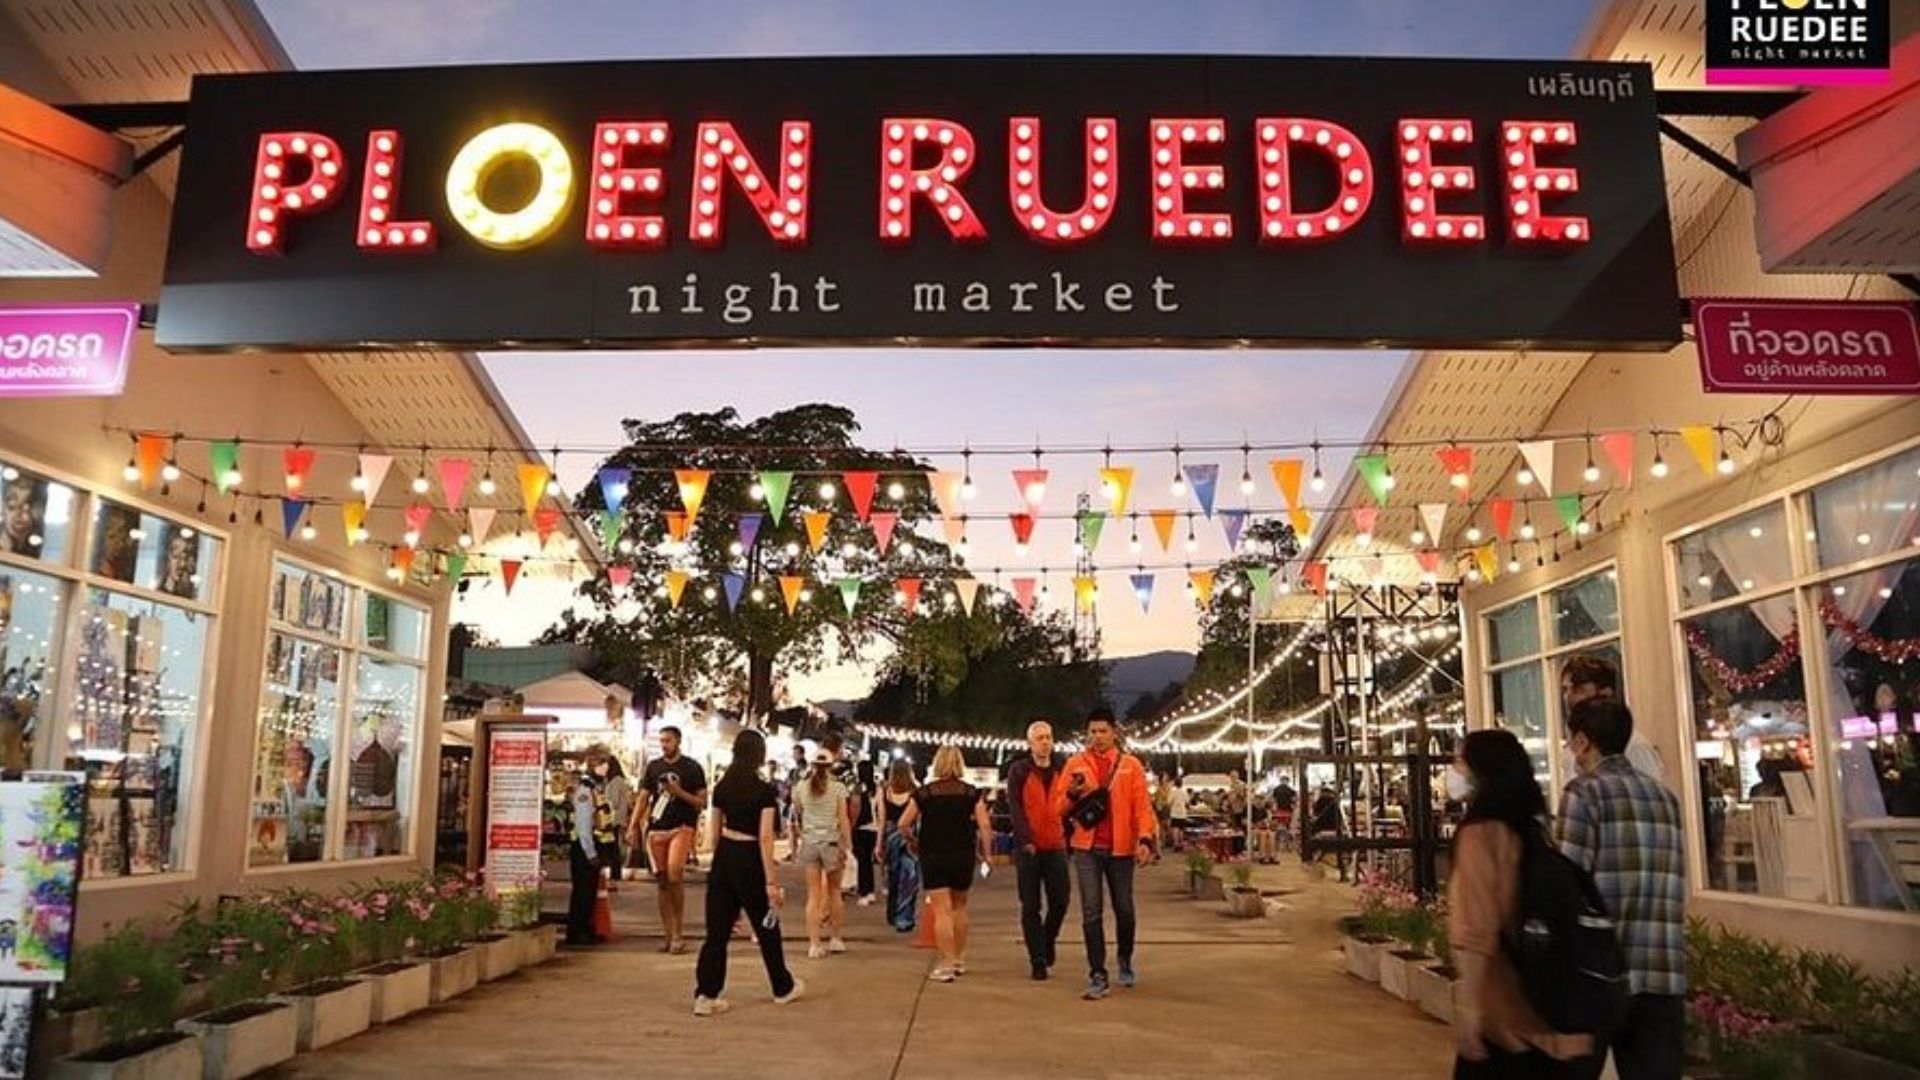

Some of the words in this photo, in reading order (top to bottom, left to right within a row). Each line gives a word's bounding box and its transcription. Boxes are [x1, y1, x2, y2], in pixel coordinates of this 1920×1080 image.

[1527, 72, 1634, 103] เพลินฤดี
[246, 121, 812, 252] PLOEN
[880, 117, 1591, 245] RUEDEE
[627, 272, 843, 323] night
[913, 271, 1181, 313] market
[1728, 311, 1893, 357] ที่จอดรถ
